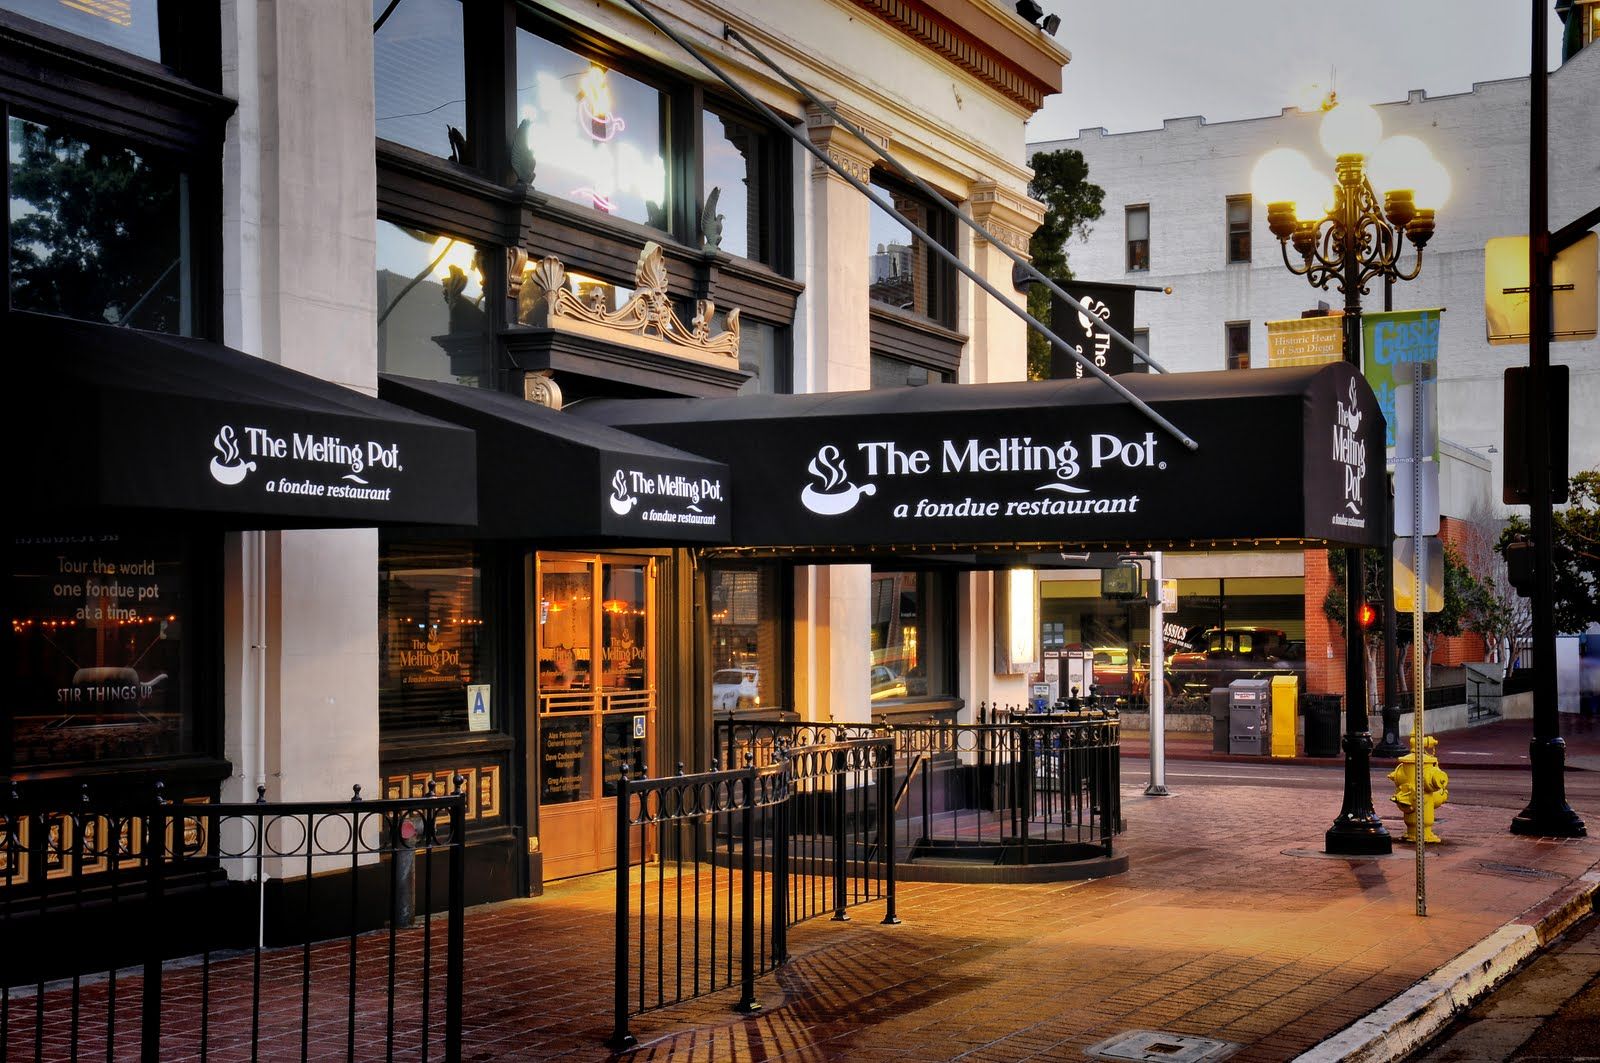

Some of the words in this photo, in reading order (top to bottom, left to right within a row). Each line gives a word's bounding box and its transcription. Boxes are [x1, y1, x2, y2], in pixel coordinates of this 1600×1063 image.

[1095, 333, 1111, 367] The
[1274, 335, 1309, 346] Historic
[1311, 333, 1337, 343] Heart
[1276, 346, 1286, 355] of
[1288, 347, 1305, 355] San
[1307, 344, 1334, 354] Diego
[1337, 401, 1349, 427] The
[244, 427, 288, 459] The
[293, 433, 364, 473] Melting
[857, 442, 931, 475] The
[942, 437, 1080, 480] Melting
[1332, 424, 1366, 478] Melting
[266, 480, 275, 492] a
[278, 478, 325, 496] fondue
[326, 484, 391, 501] restaurant
[629, 470, 655, 494] The
[657, 474, 700, 504] Melting
[642, 511, 648, 520] a
[649, 509, 677, 523] fondue
[677, 513, 716, 525] restaurant
[893, 503, 909, 518] a
[914, 498, 1000, 518] fondue
[1005, 495, 1140, 516] restaurant
[57, 555, 88, 573] Tour
[93, 557, 116, 574] the
[120, 560, 155, 576] world
[53, 583, 82, 597] one
[86, 580, 135, 598] fondue
[138, 583, 160, 601] pot
[76, 606, 91, 620] at
[94, 609, 103, 619] a
[1162, 621, 1188, 641] ASSICS
[412, 639, 426, 650] The
[400, 650, 440, 670] Melting
[57, 687, 81, 702] STIR
[87, 686, 136, 701] THINGS
[473, 691, 485, 713] A
